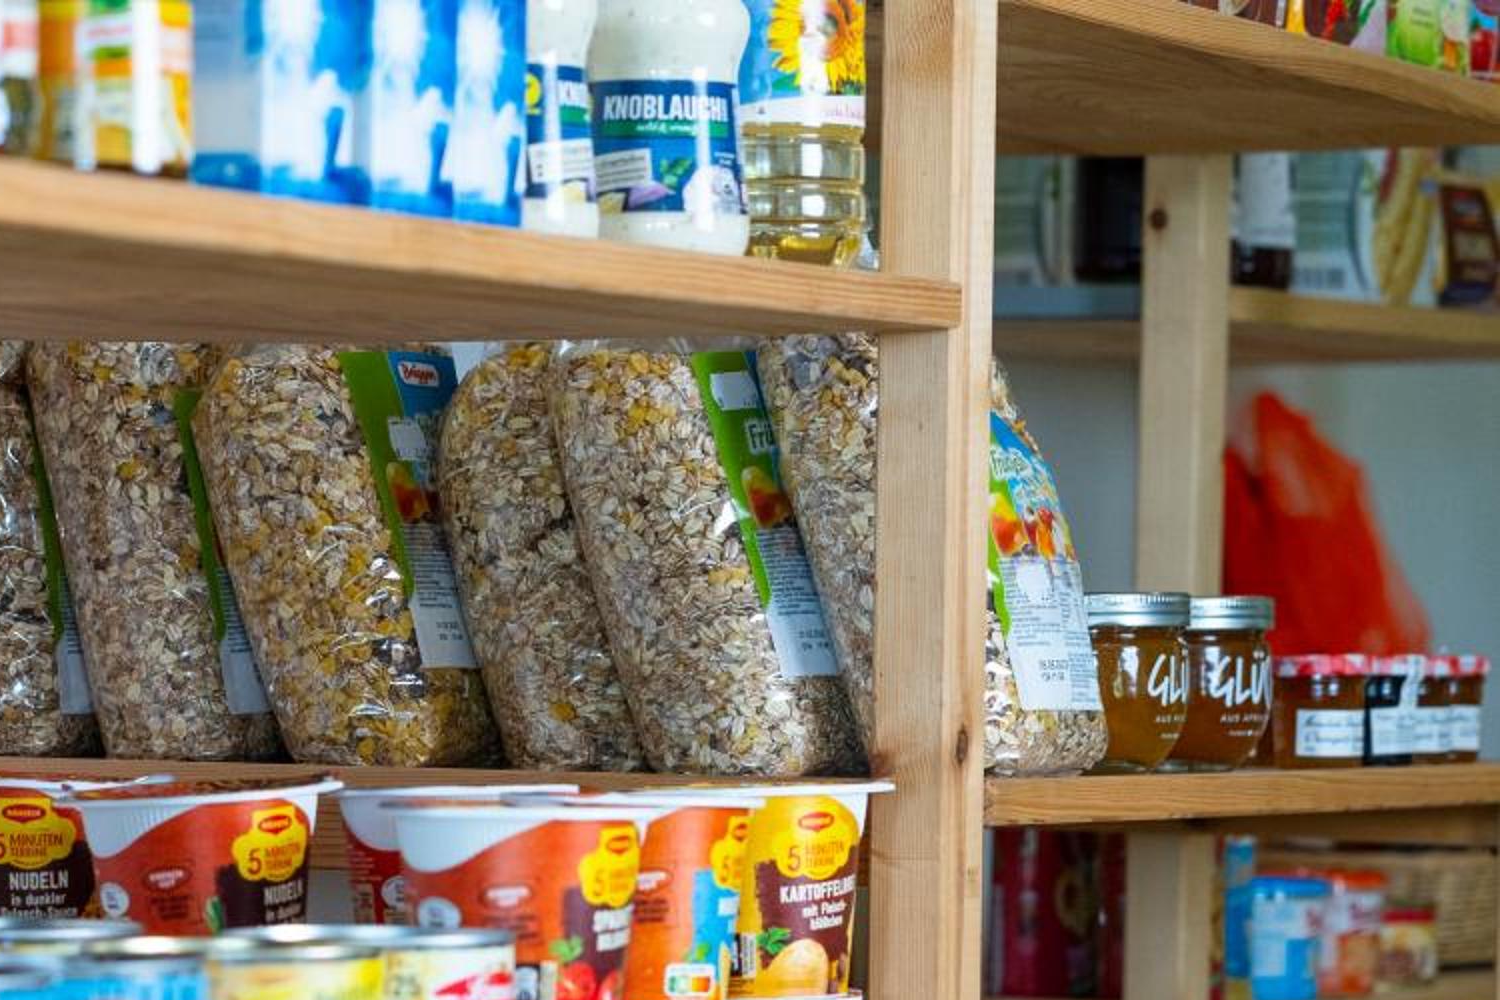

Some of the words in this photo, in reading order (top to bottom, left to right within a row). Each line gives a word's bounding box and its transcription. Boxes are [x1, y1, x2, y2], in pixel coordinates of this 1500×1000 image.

[9, 832, 63, 849] MINUTEN
[247, 848, 261, 875] 5
[787, 844, 800, 872] 5
[9, 869, 69, 890] NUDELN
